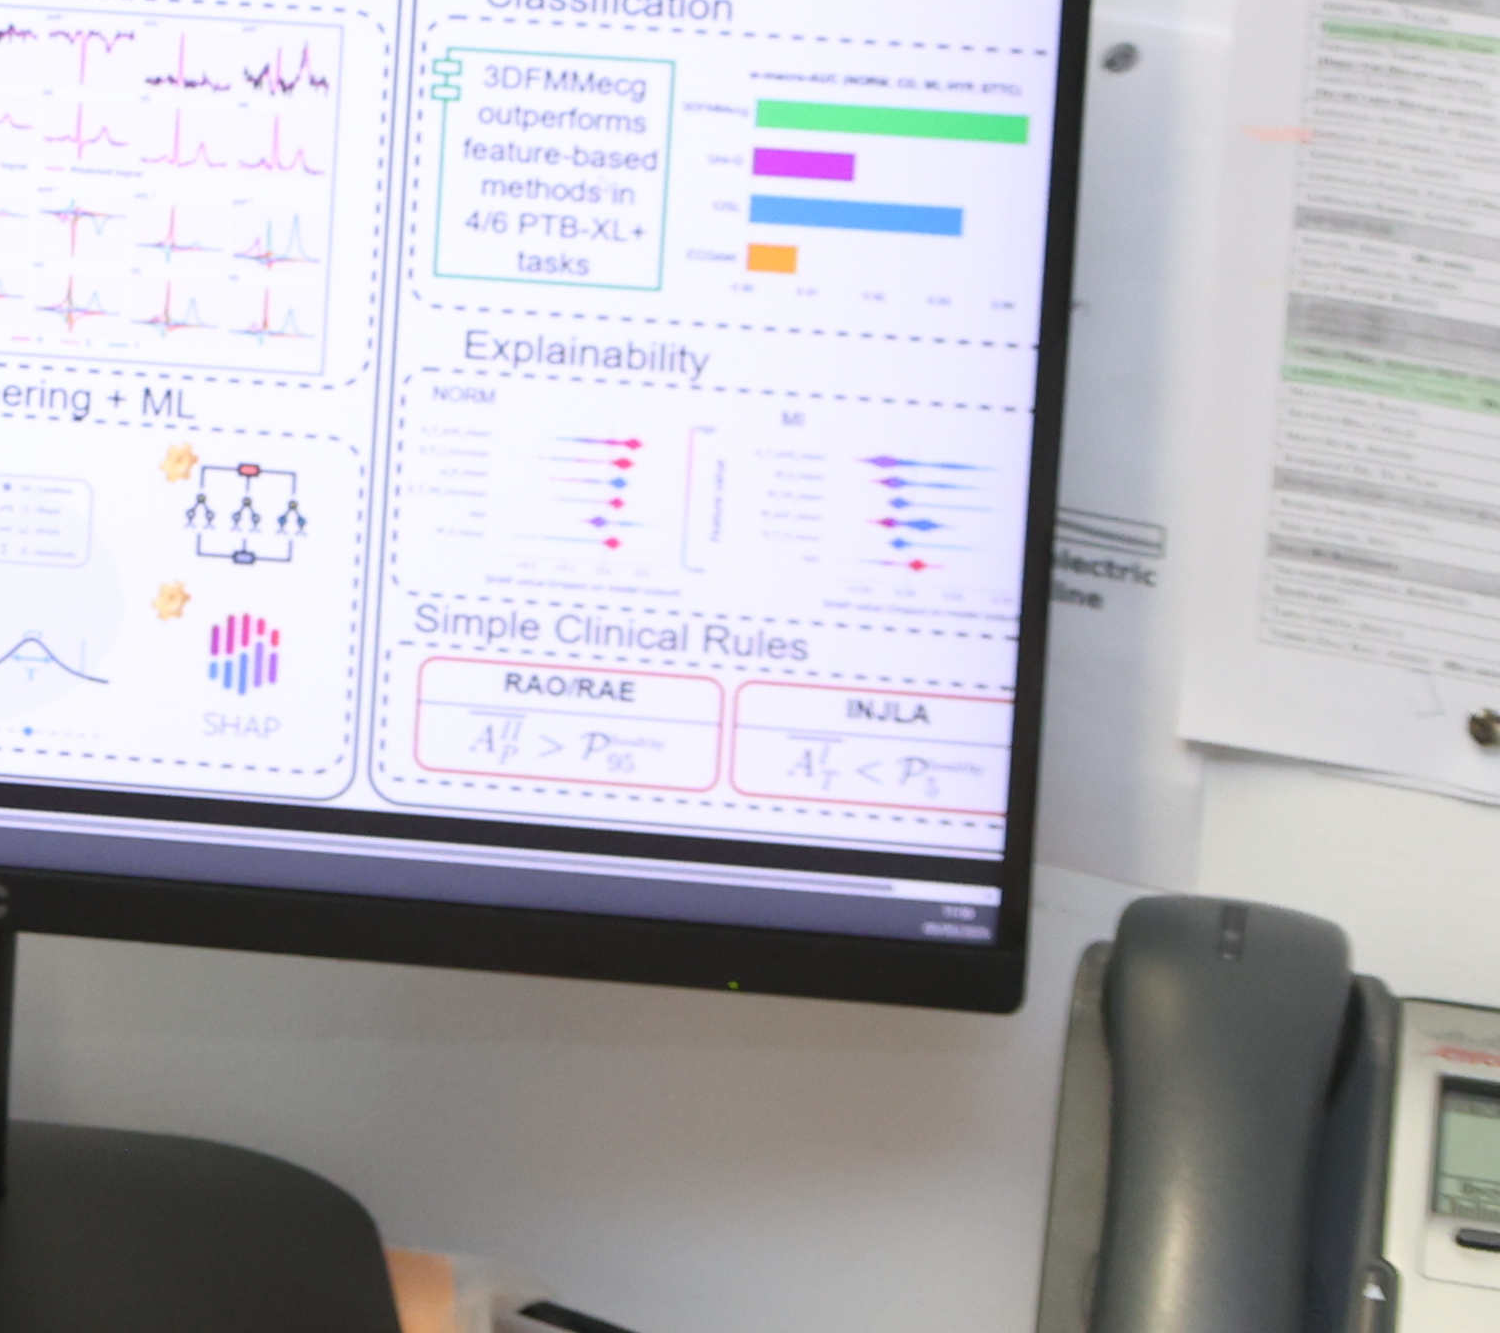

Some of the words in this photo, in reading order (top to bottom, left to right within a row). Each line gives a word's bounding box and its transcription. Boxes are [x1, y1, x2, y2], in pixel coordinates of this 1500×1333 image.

[484, 64, 647, 105] 3DFMMecg
[476, 101, 647, 135] outperforms
[462, 136, 659, 172] feature-based
[480, 178, 602, 204] methods
[610, 186, 636, 205] in
[464, 210, 508, 234] 4/6
[518, 212, 645, 243] PTB-XL+
[517, 251, 590, 277] tasks
[461, 328, 710, 383] Explainability
[108, 391, 125, 407] +
[142, 386, 194, 419] ML
[432, 385, 497, 404] NORM
[781, 411, 804, 426] MI
[1054, 550, 1157, 587] lectric
[414, 601, 542, 647] Simple
[552, 610, 690, 655] Clinical
[702, 624, 810, 667] Rules
[504, 669, 638, 703] RAO/RAE
[203, 710, 281, 739] SHAP
